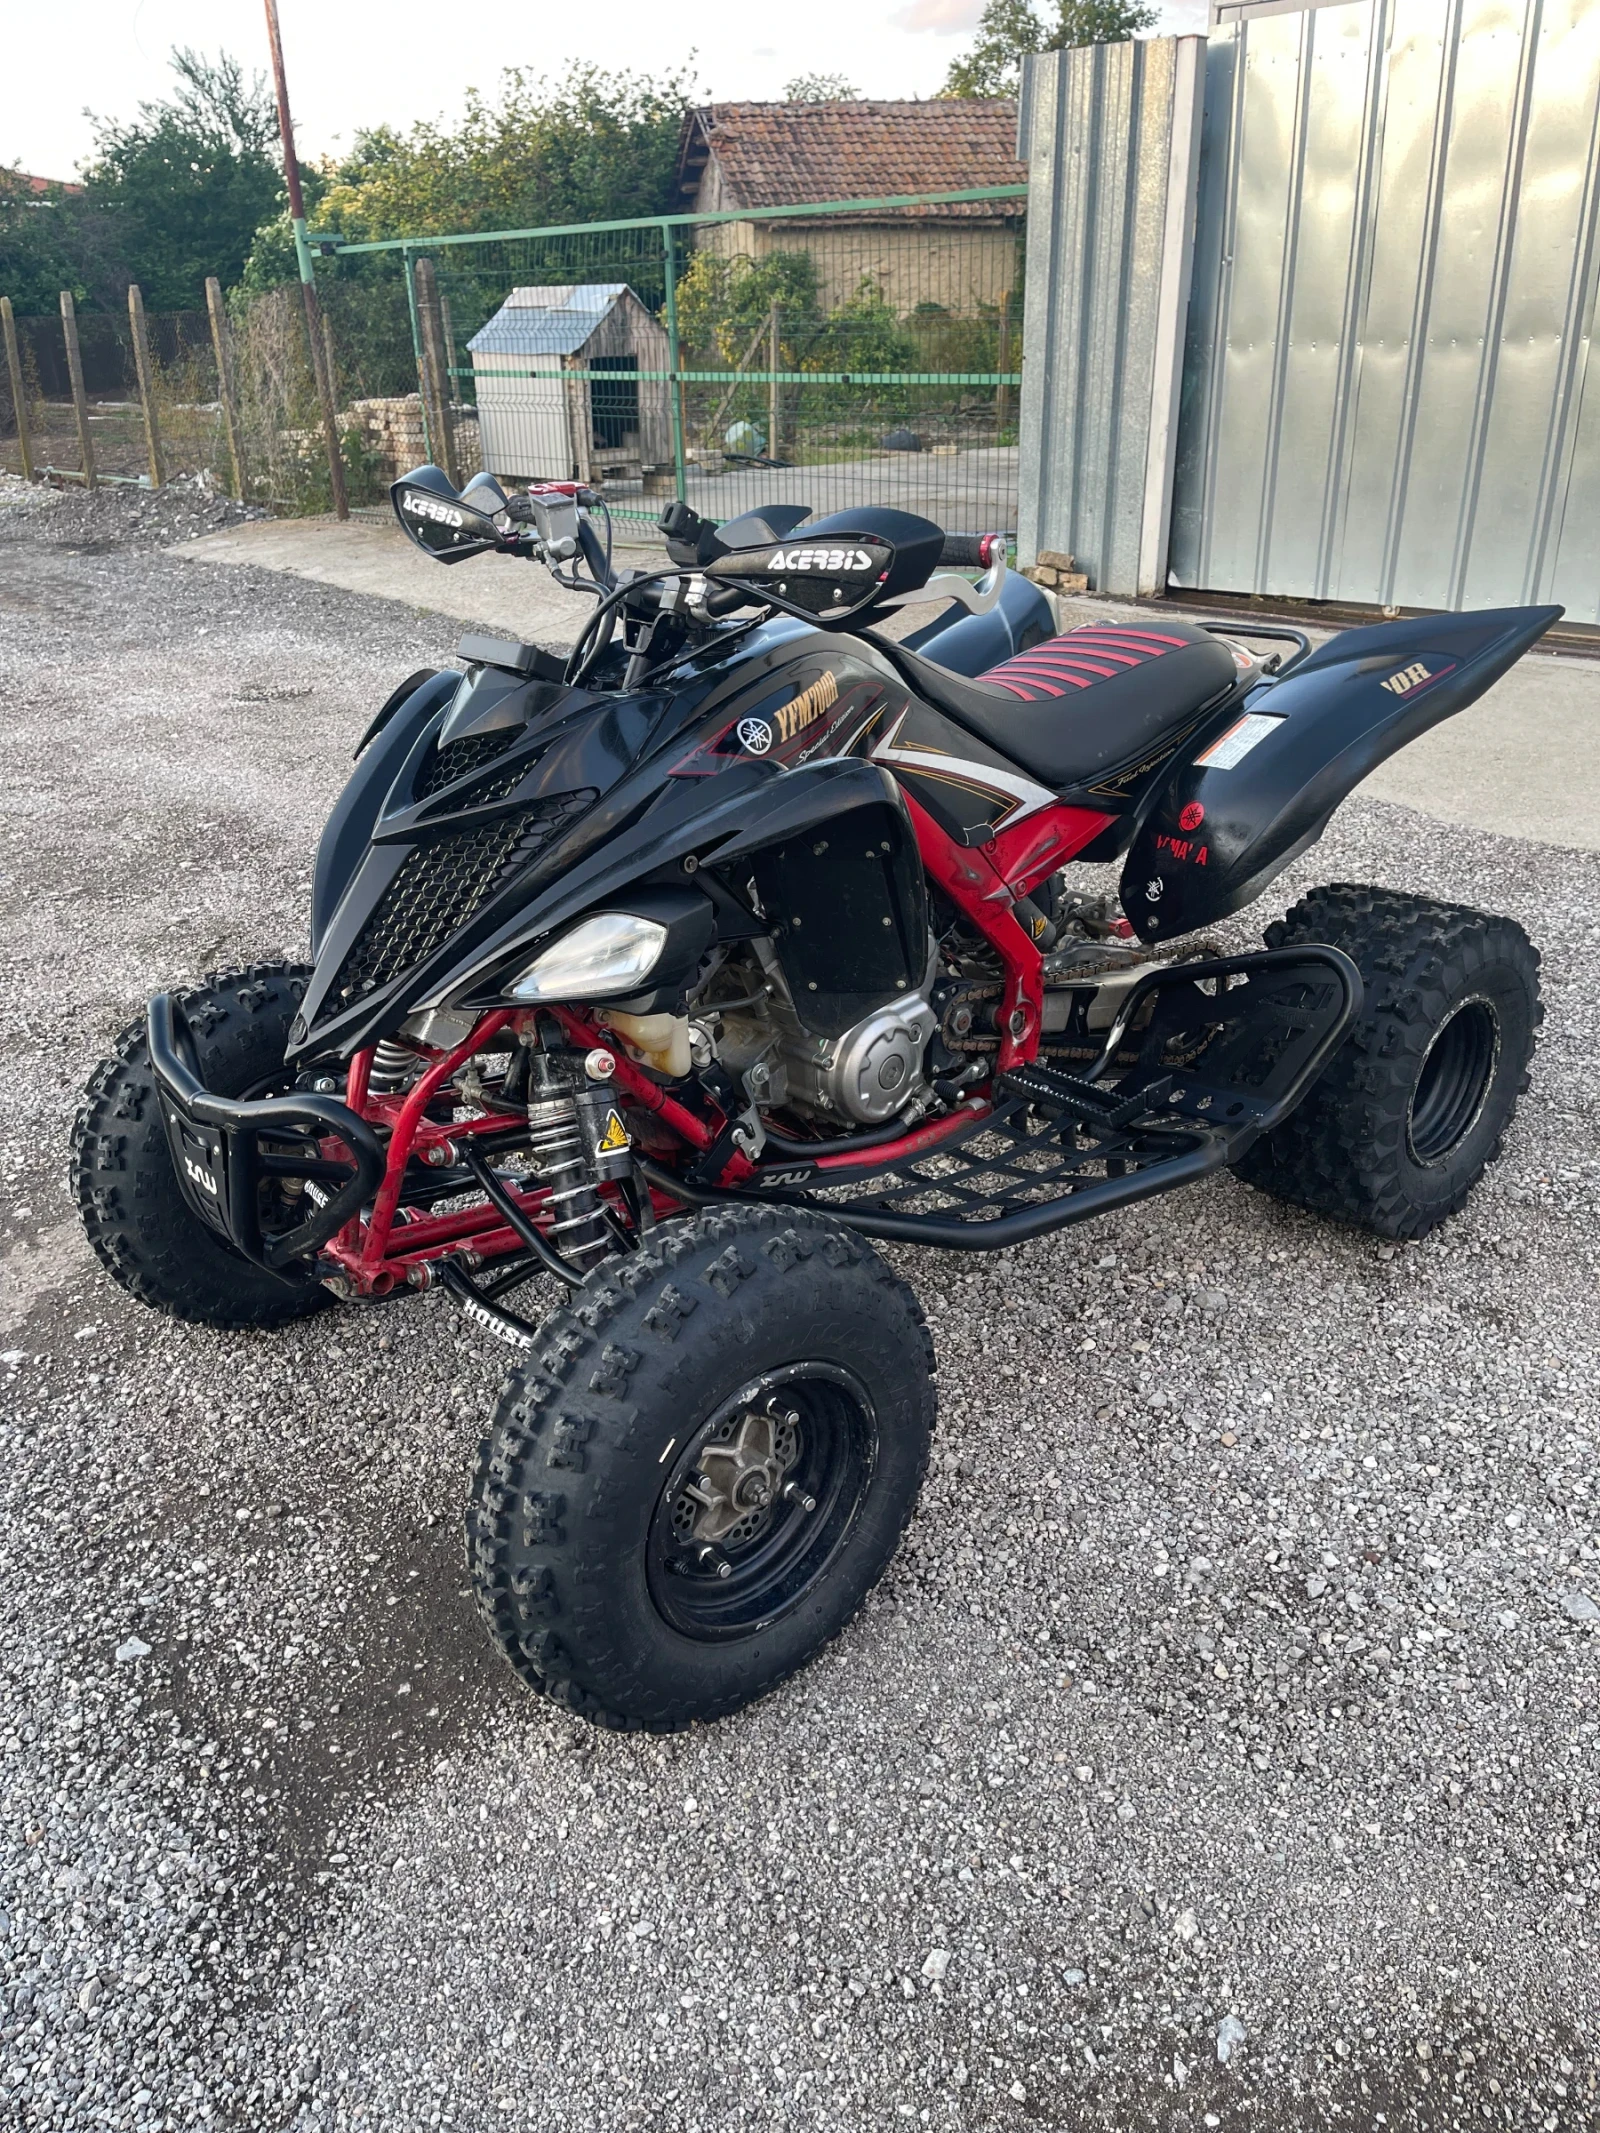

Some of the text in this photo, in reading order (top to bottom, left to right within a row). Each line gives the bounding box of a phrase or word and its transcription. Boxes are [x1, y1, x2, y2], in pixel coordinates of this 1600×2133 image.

[773, 670, 839, 743] YFM700R
[795, 705, 855, 766] Special Edition
